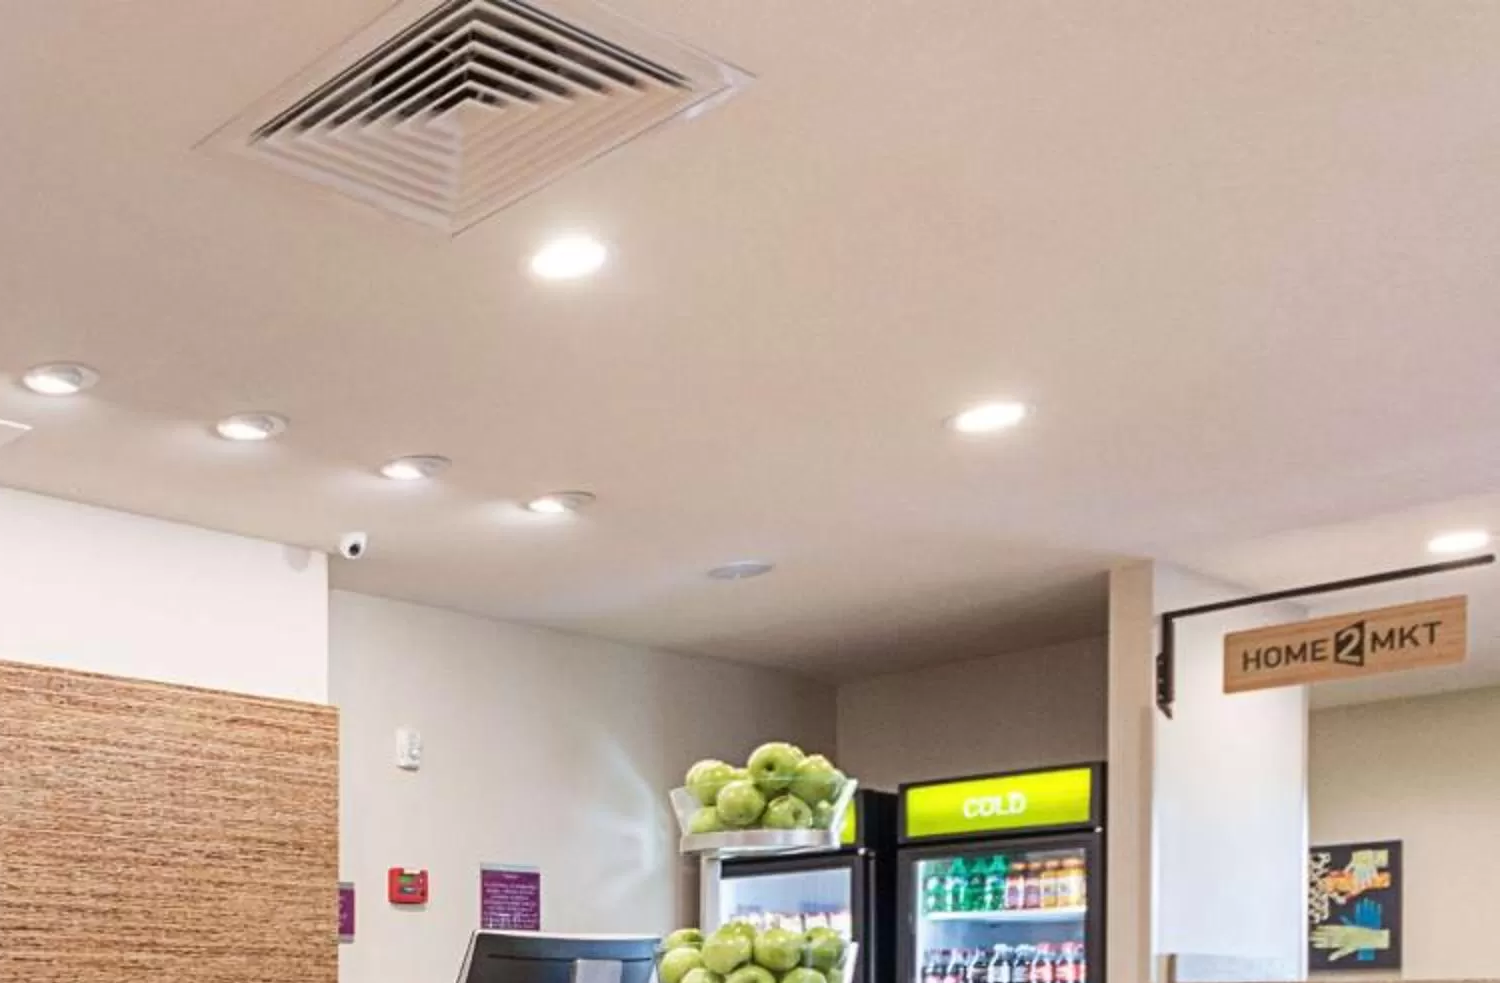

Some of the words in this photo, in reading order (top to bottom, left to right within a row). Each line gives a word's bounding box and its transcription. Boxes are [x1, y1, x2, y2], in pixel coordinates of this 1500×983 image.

[1242, 638, 1329, 672] HOME
[1336, 624, 1362, 664] 2
[1370, 620, 1443, 654] MKT
[963, 791, 1027, 820] COLD
